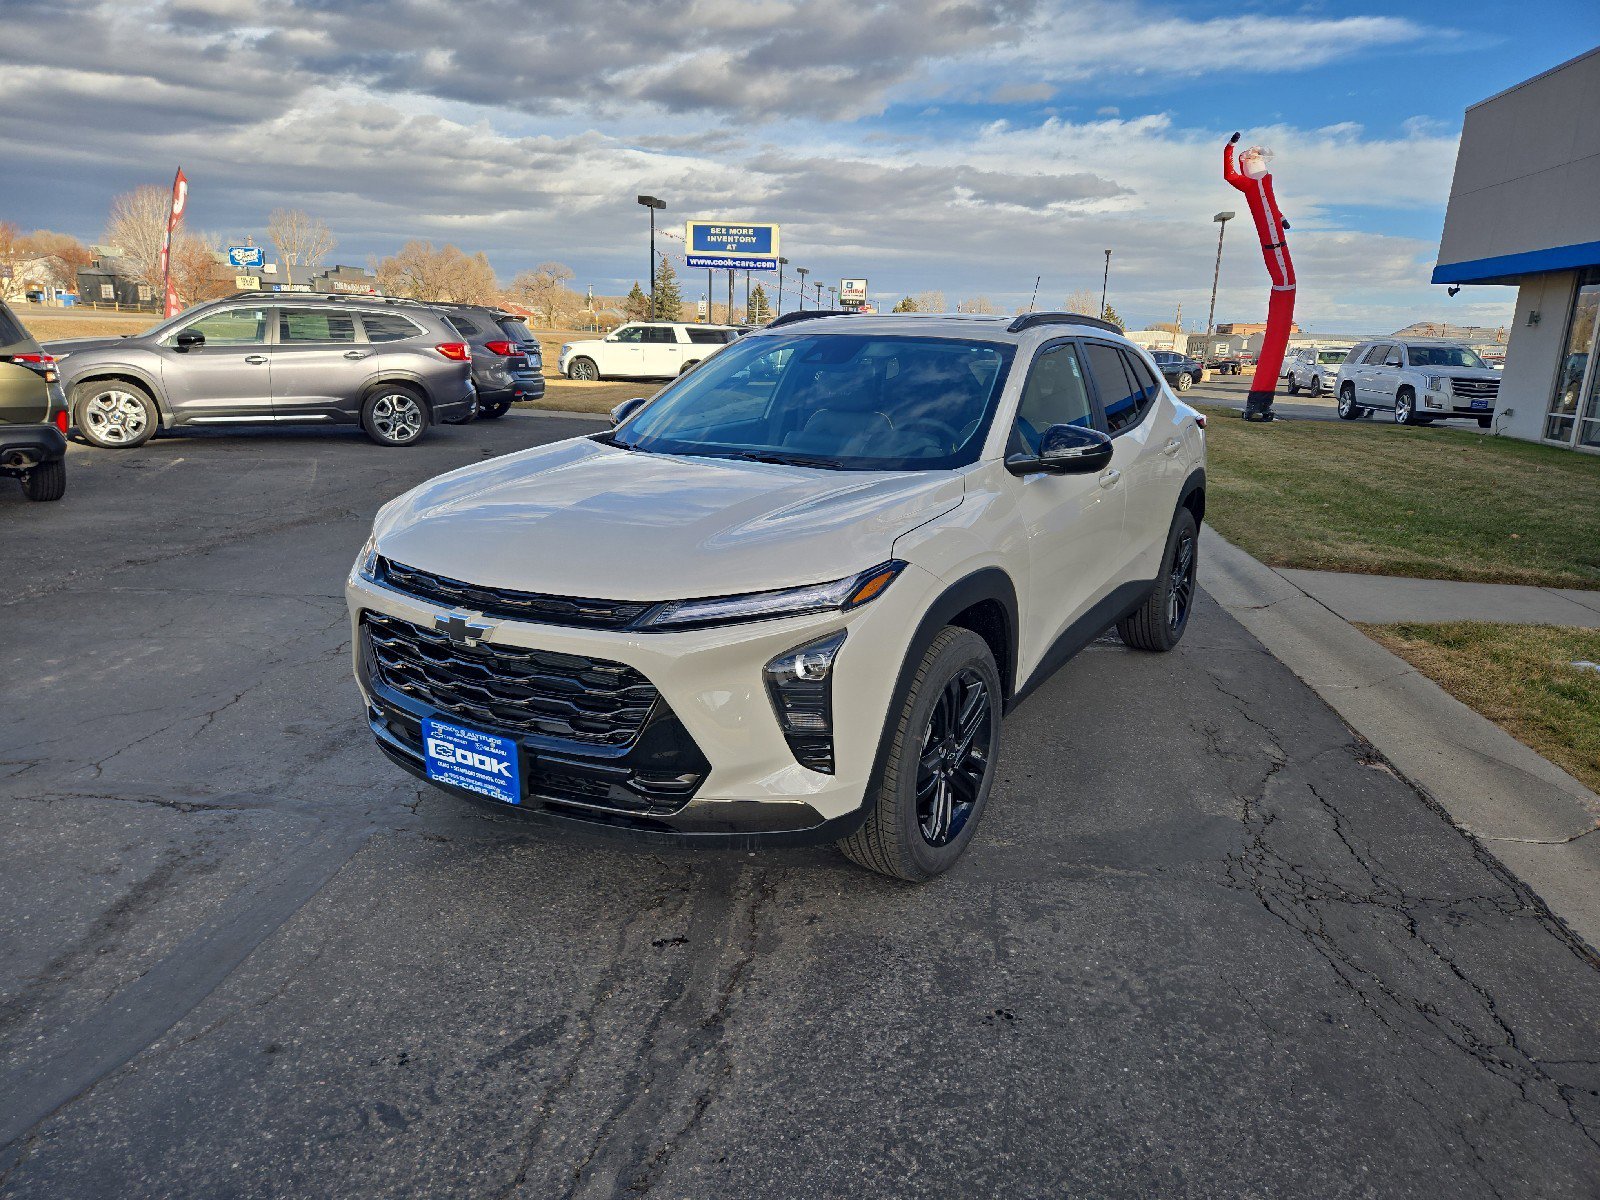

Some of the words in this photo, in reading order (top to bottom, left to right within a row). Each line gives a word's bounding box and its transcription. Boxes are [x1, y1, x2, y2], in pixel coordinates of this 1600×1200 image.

[707, 235, 757, 243] INVENTORY
[690, 258, 775, 268] www.cook-cars.com
[467, 732, 502, 745] ALTITUDE
[427, 737, 513, 778] COOK
[431, 774, 513, 804] COOK-CARS.COM
